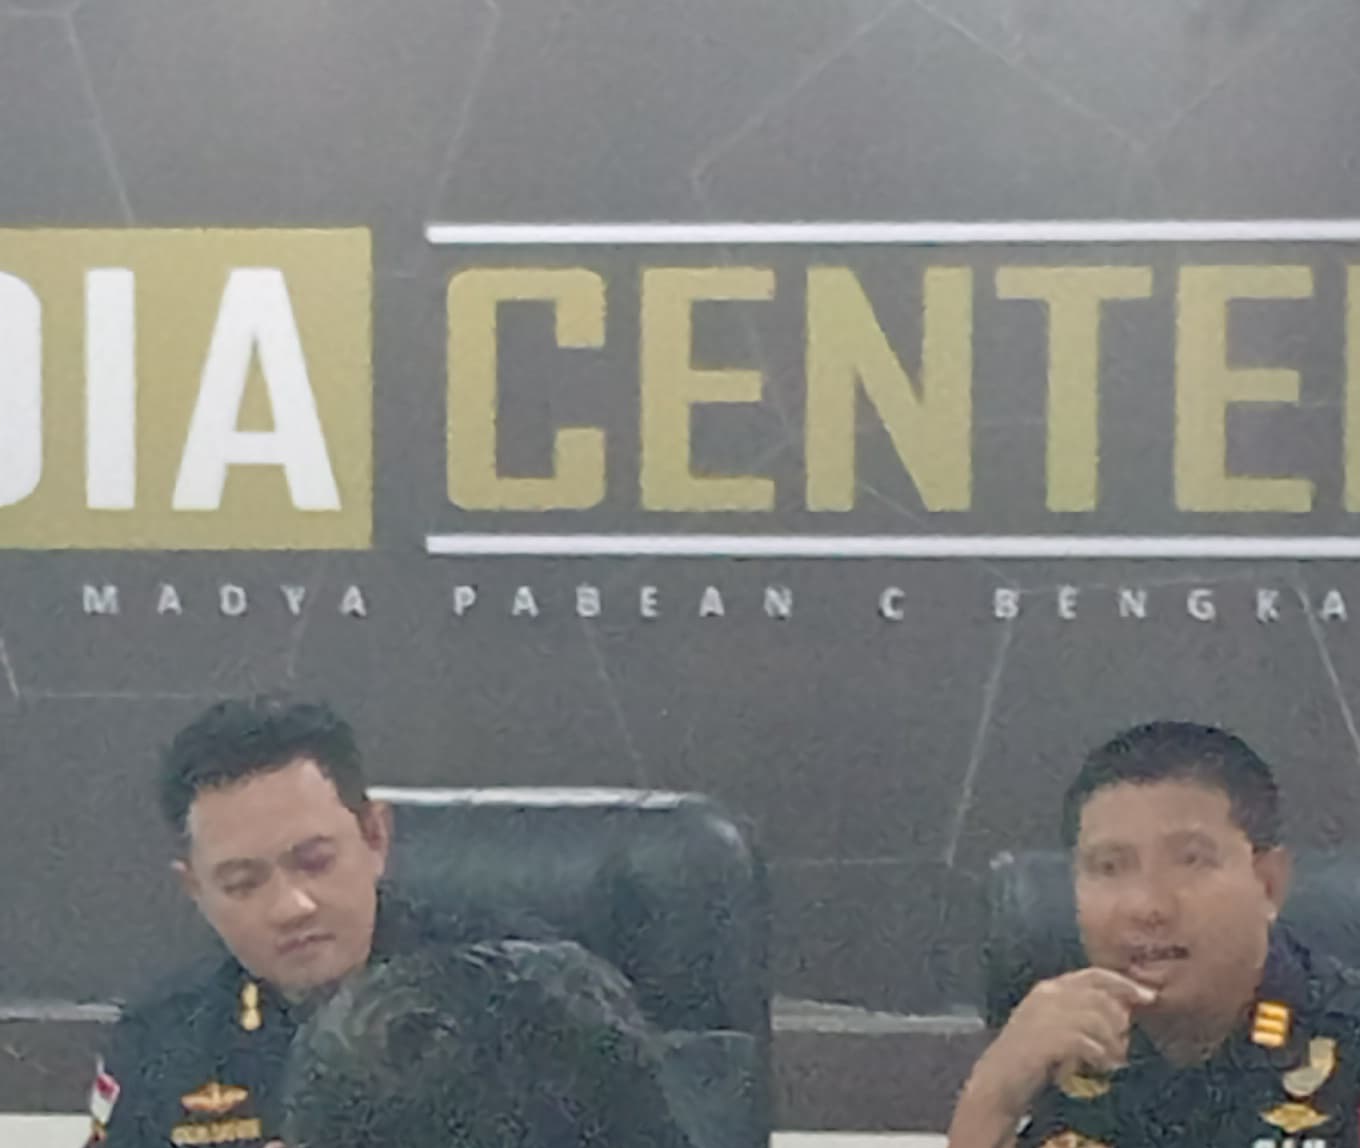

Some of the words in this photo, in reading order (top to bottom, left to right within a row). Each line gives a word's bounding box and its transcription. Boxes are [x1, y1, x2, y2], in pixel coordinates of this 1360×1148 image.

[82, 584, 368, 616] MADYA
[452, 585, 792, 618] PABEAN
[879, 588, 906, 620] C
